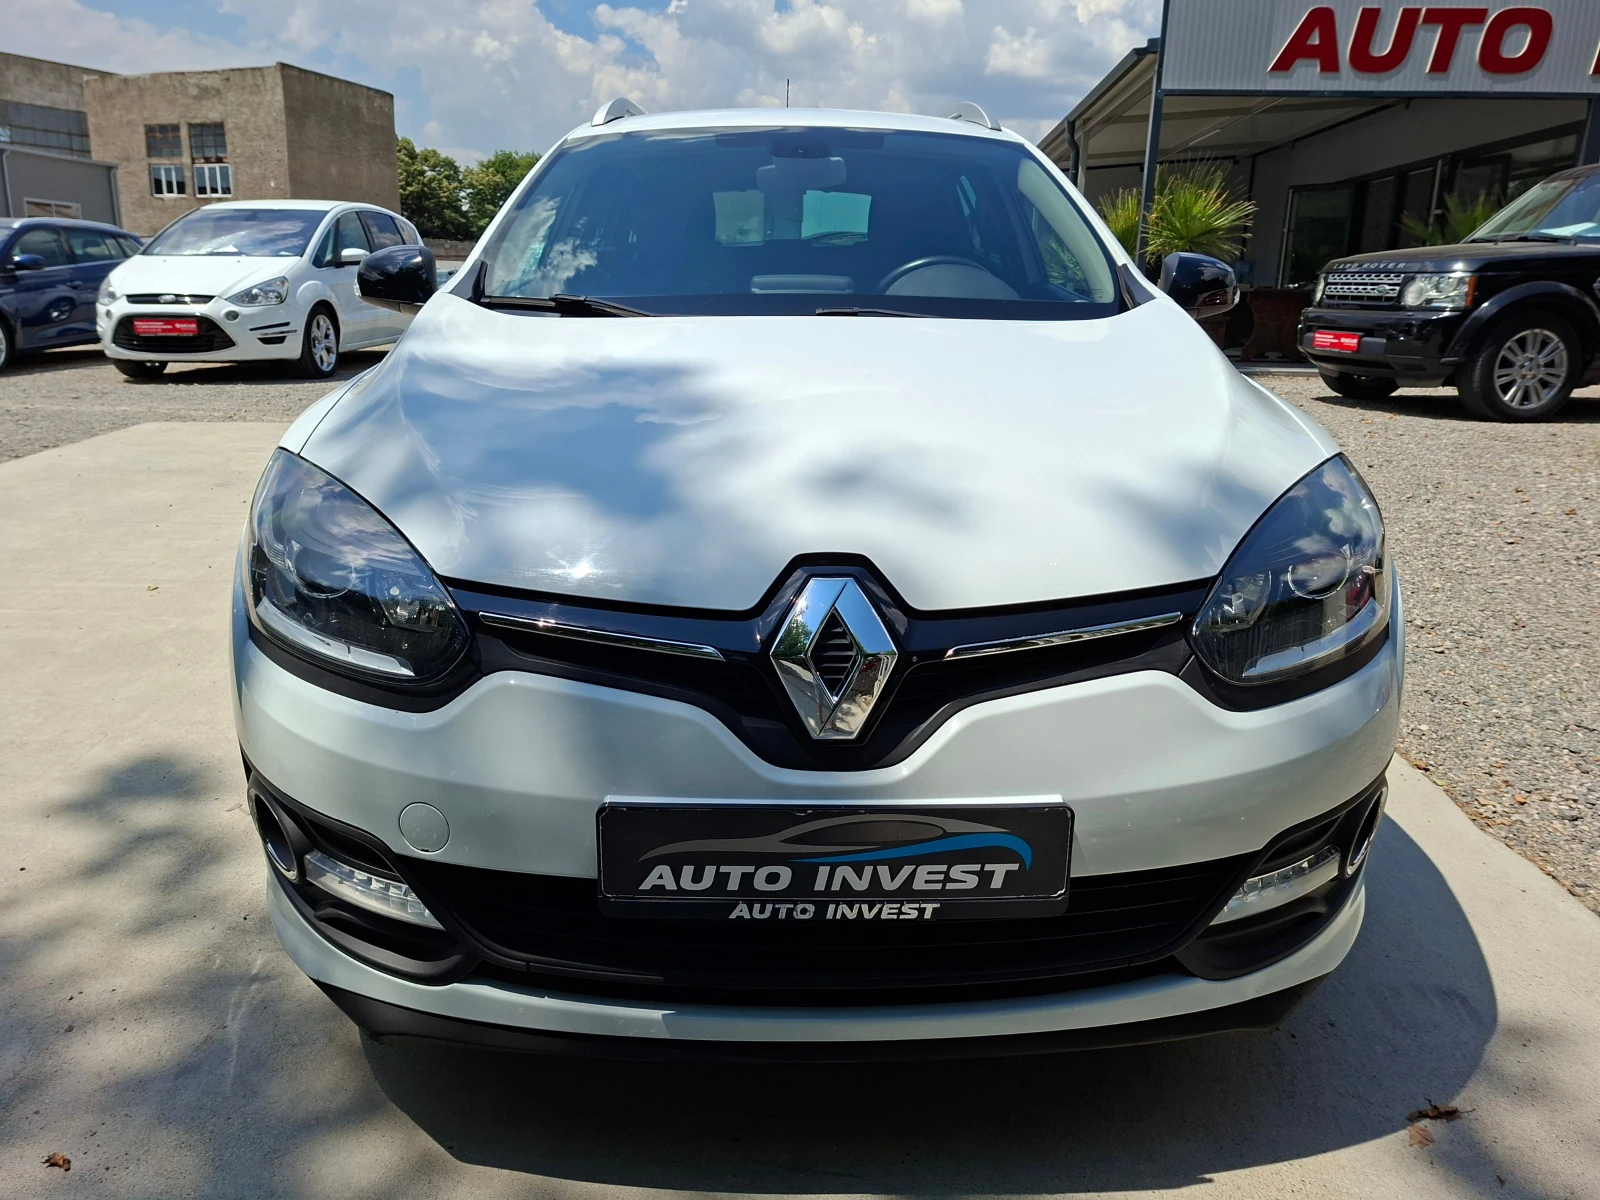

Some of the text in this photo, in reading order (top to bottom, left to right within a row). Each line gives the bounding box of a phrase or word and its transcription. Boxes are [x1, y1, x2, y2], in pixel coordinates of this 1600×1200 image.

[1267, 6, 1554, 74] AUTO
[638, 864, 1020, 890] AUTO INVEST
[729, 903, 940, 919] AUTO INVEST
